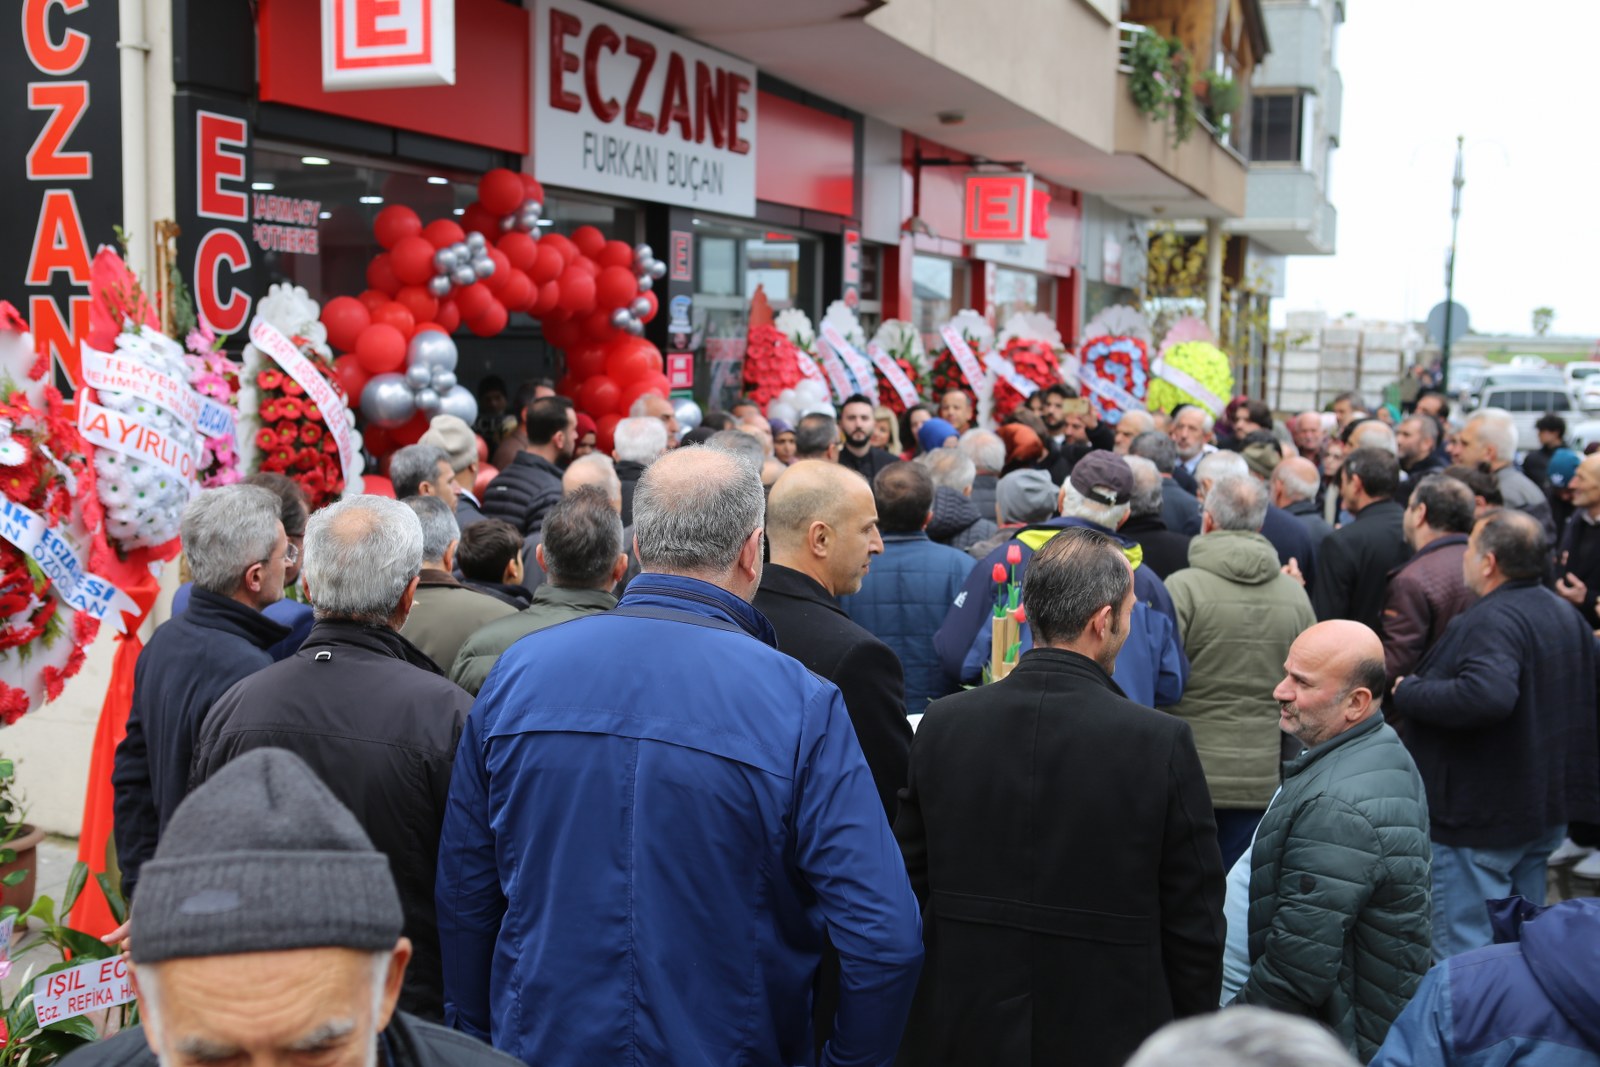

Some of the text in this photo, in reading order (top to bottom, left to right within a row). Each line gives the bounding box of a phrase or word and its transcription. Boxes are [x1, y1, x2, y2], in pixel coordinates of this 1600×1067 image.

[550, 8, 751, 155] ECZANE
[583, 131, 724, 201] FURKAN BUÇAN
[23, 0, 93, 423] CZAN
[105, 357, 178, 393] TEKYER
[1, 500, 31, 529] IK
[47, 969, 86, 1000] IŞIL
[68, 987, 114, 1014] REFİKA
